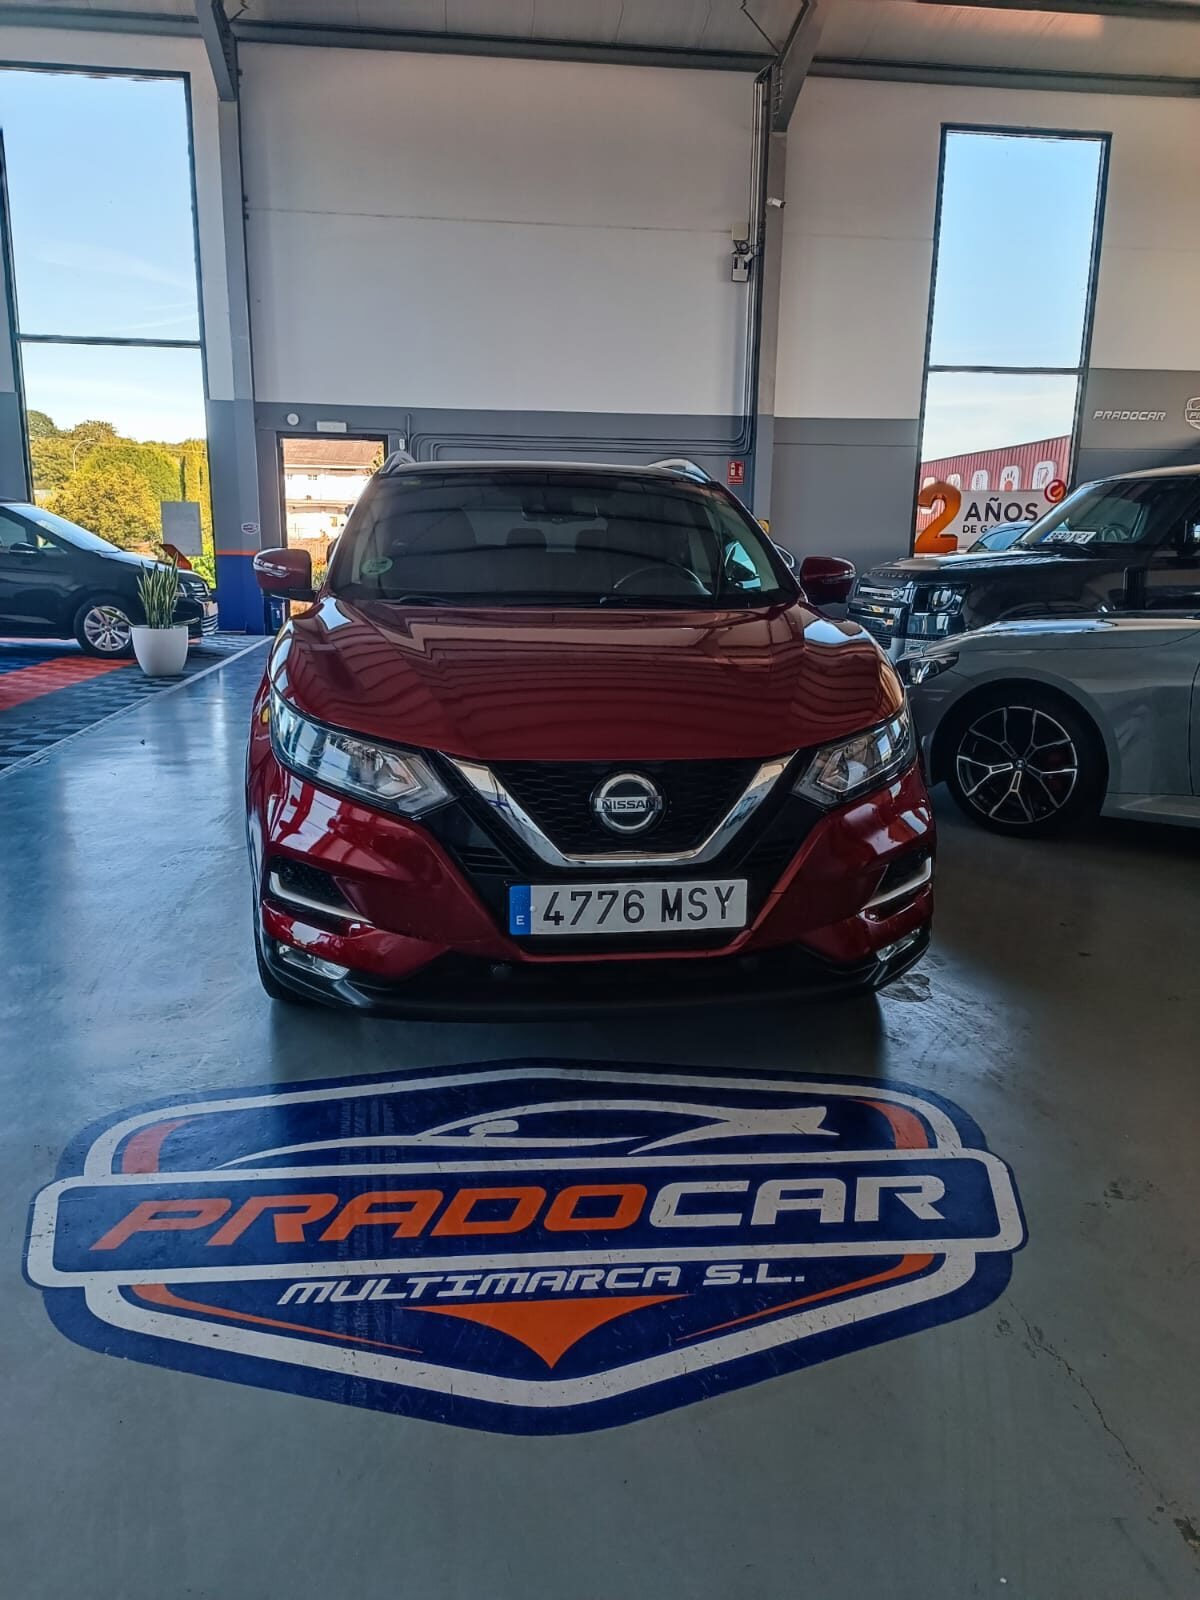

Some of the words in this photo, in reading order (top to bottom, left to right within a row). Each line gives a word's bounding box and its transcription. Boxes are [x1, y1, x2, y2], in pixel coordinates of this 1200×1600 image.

[1093, 410, 1166, 421] PRADOCAR
[915, 481, 962, 554] 2
[963, 496, 1038, 522] AÑOS
[962, 525, 977, 534] DE
[601, 799, 659, 811] NISSAN
[516, 915, 525, 926] E
[543, 890, 645, 926] 4776
[660, 885, 735, 923] MSY
[89, 1174, 946, 1251] PRADOCAR
[277, 1265, 681, 1306] MULTIMARCA
[702, 1263, 805, 1287] S.L.
